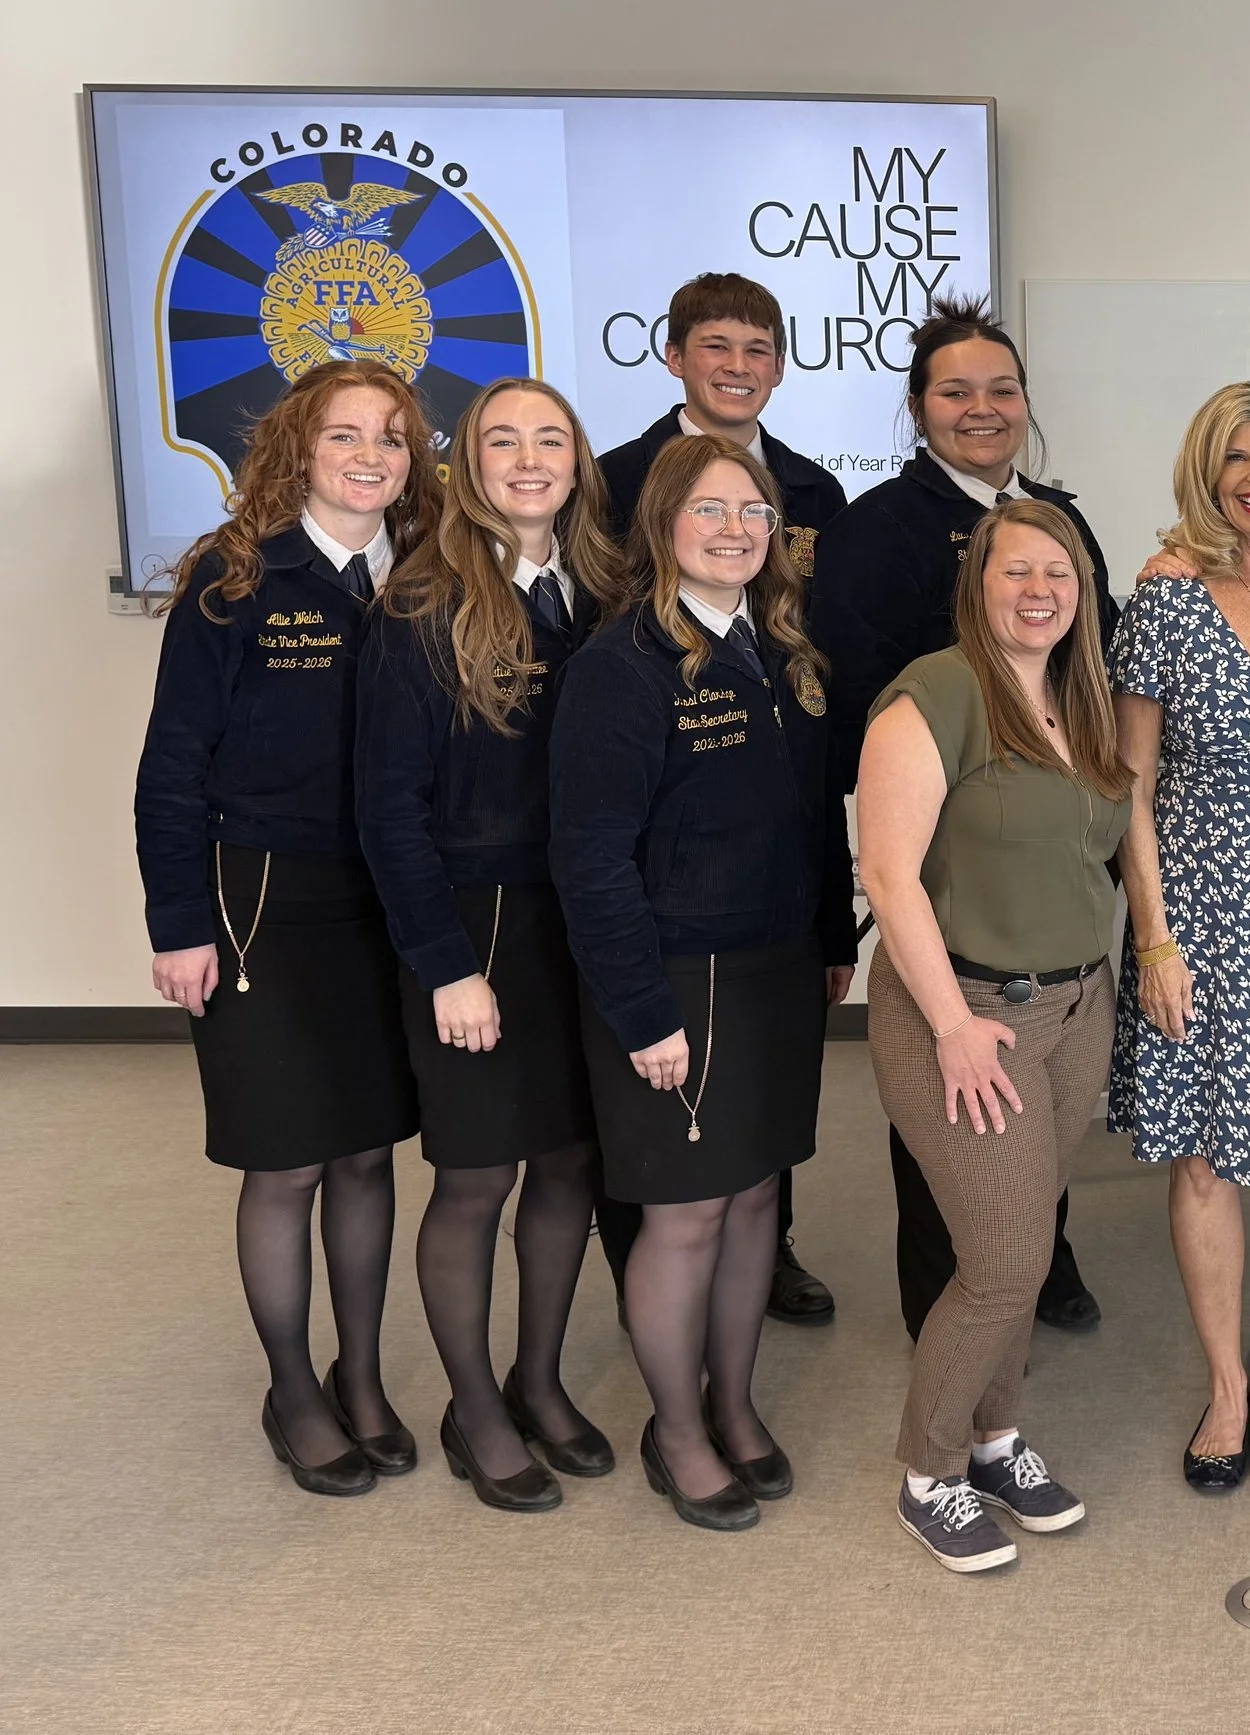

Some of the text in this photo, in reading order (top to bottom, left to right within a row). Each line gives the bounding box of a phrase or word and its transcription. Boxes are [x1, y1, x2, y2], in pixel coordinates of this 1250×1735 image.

[210, 123, 468, 188] COLORADO
[853, 147, 946, 203] MY
[749, 201, 960, 261] CAUSE
[286, 258, 407, 310] AGRICULTURAL
[313, 281, 380, 306] FFA
[857, 261, 950, 316] MY
[828, 454, 845, 471] of
[847, 454, 887, 471] Year
[293, 610, 324, 625] Welch
[278, 635, 298, 648] Vice
[300, 633, 343, 648] President
[267, 656, 333, 669] 2025-2026
[700, 708, 748, 728] Secretary
